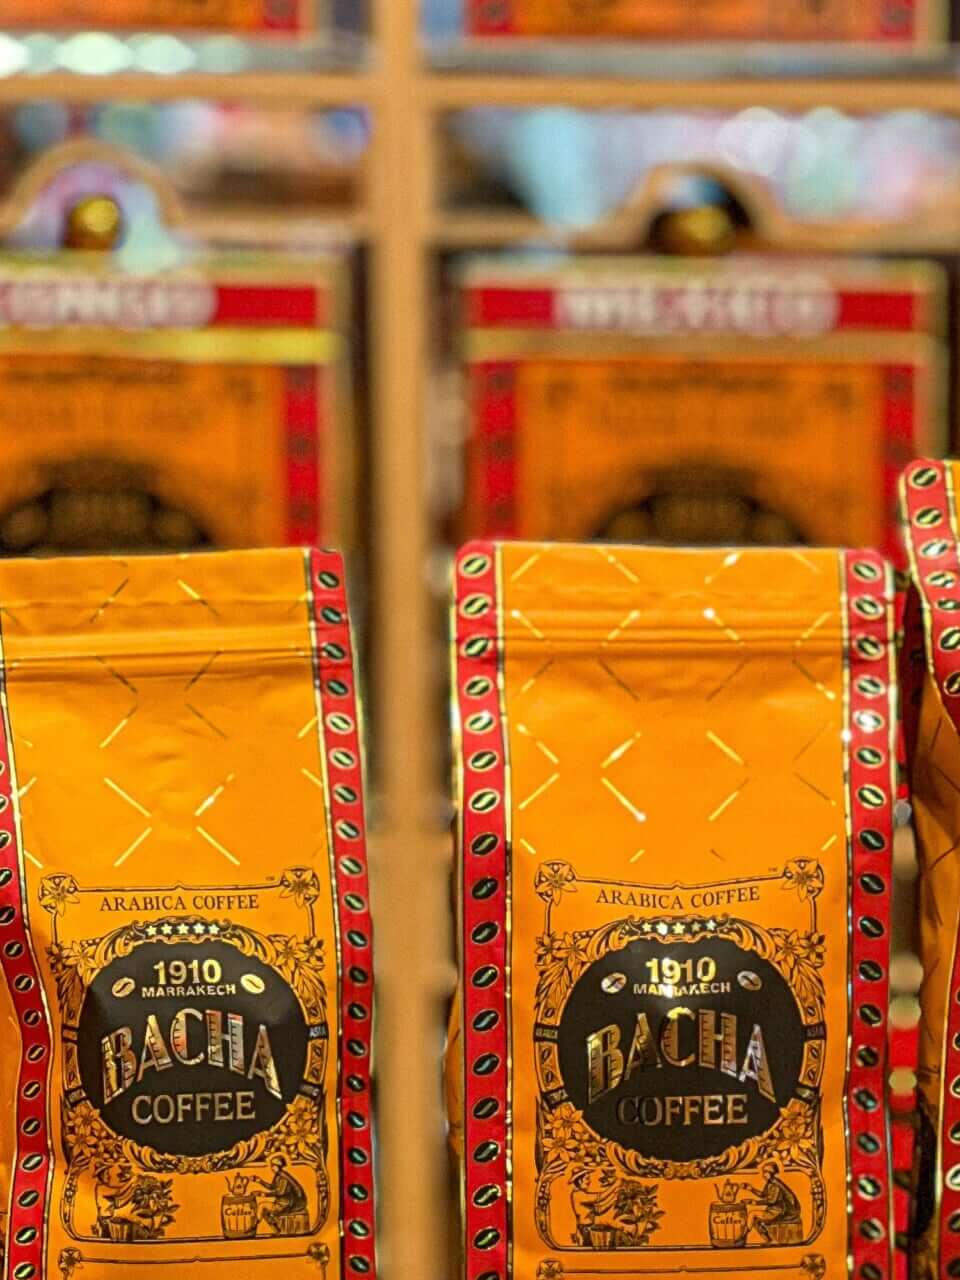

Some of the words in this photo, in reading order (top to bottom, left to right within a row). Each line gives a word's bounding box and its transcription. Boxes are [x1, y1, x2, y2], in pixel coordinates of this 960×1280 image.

[100, 895, 187, 913] ARABICA
[192, 894, 260, 911] COFFEE
[596, 888, 685, 910] ARABICA
[691, 885, 760, 908] COFFEE
[153, 959, 223, 985] 1910
[645, 956, 717, 985] 1910
[142, 984, 236, 999] MARRAKECH
[101, 1007, 282, 1104] BACHA
[587, 1006, 777, 1104] BACHA
[131, 1091, 256, 1125] COFFEE
[616, 1094, 749, 1128] COFFEE
